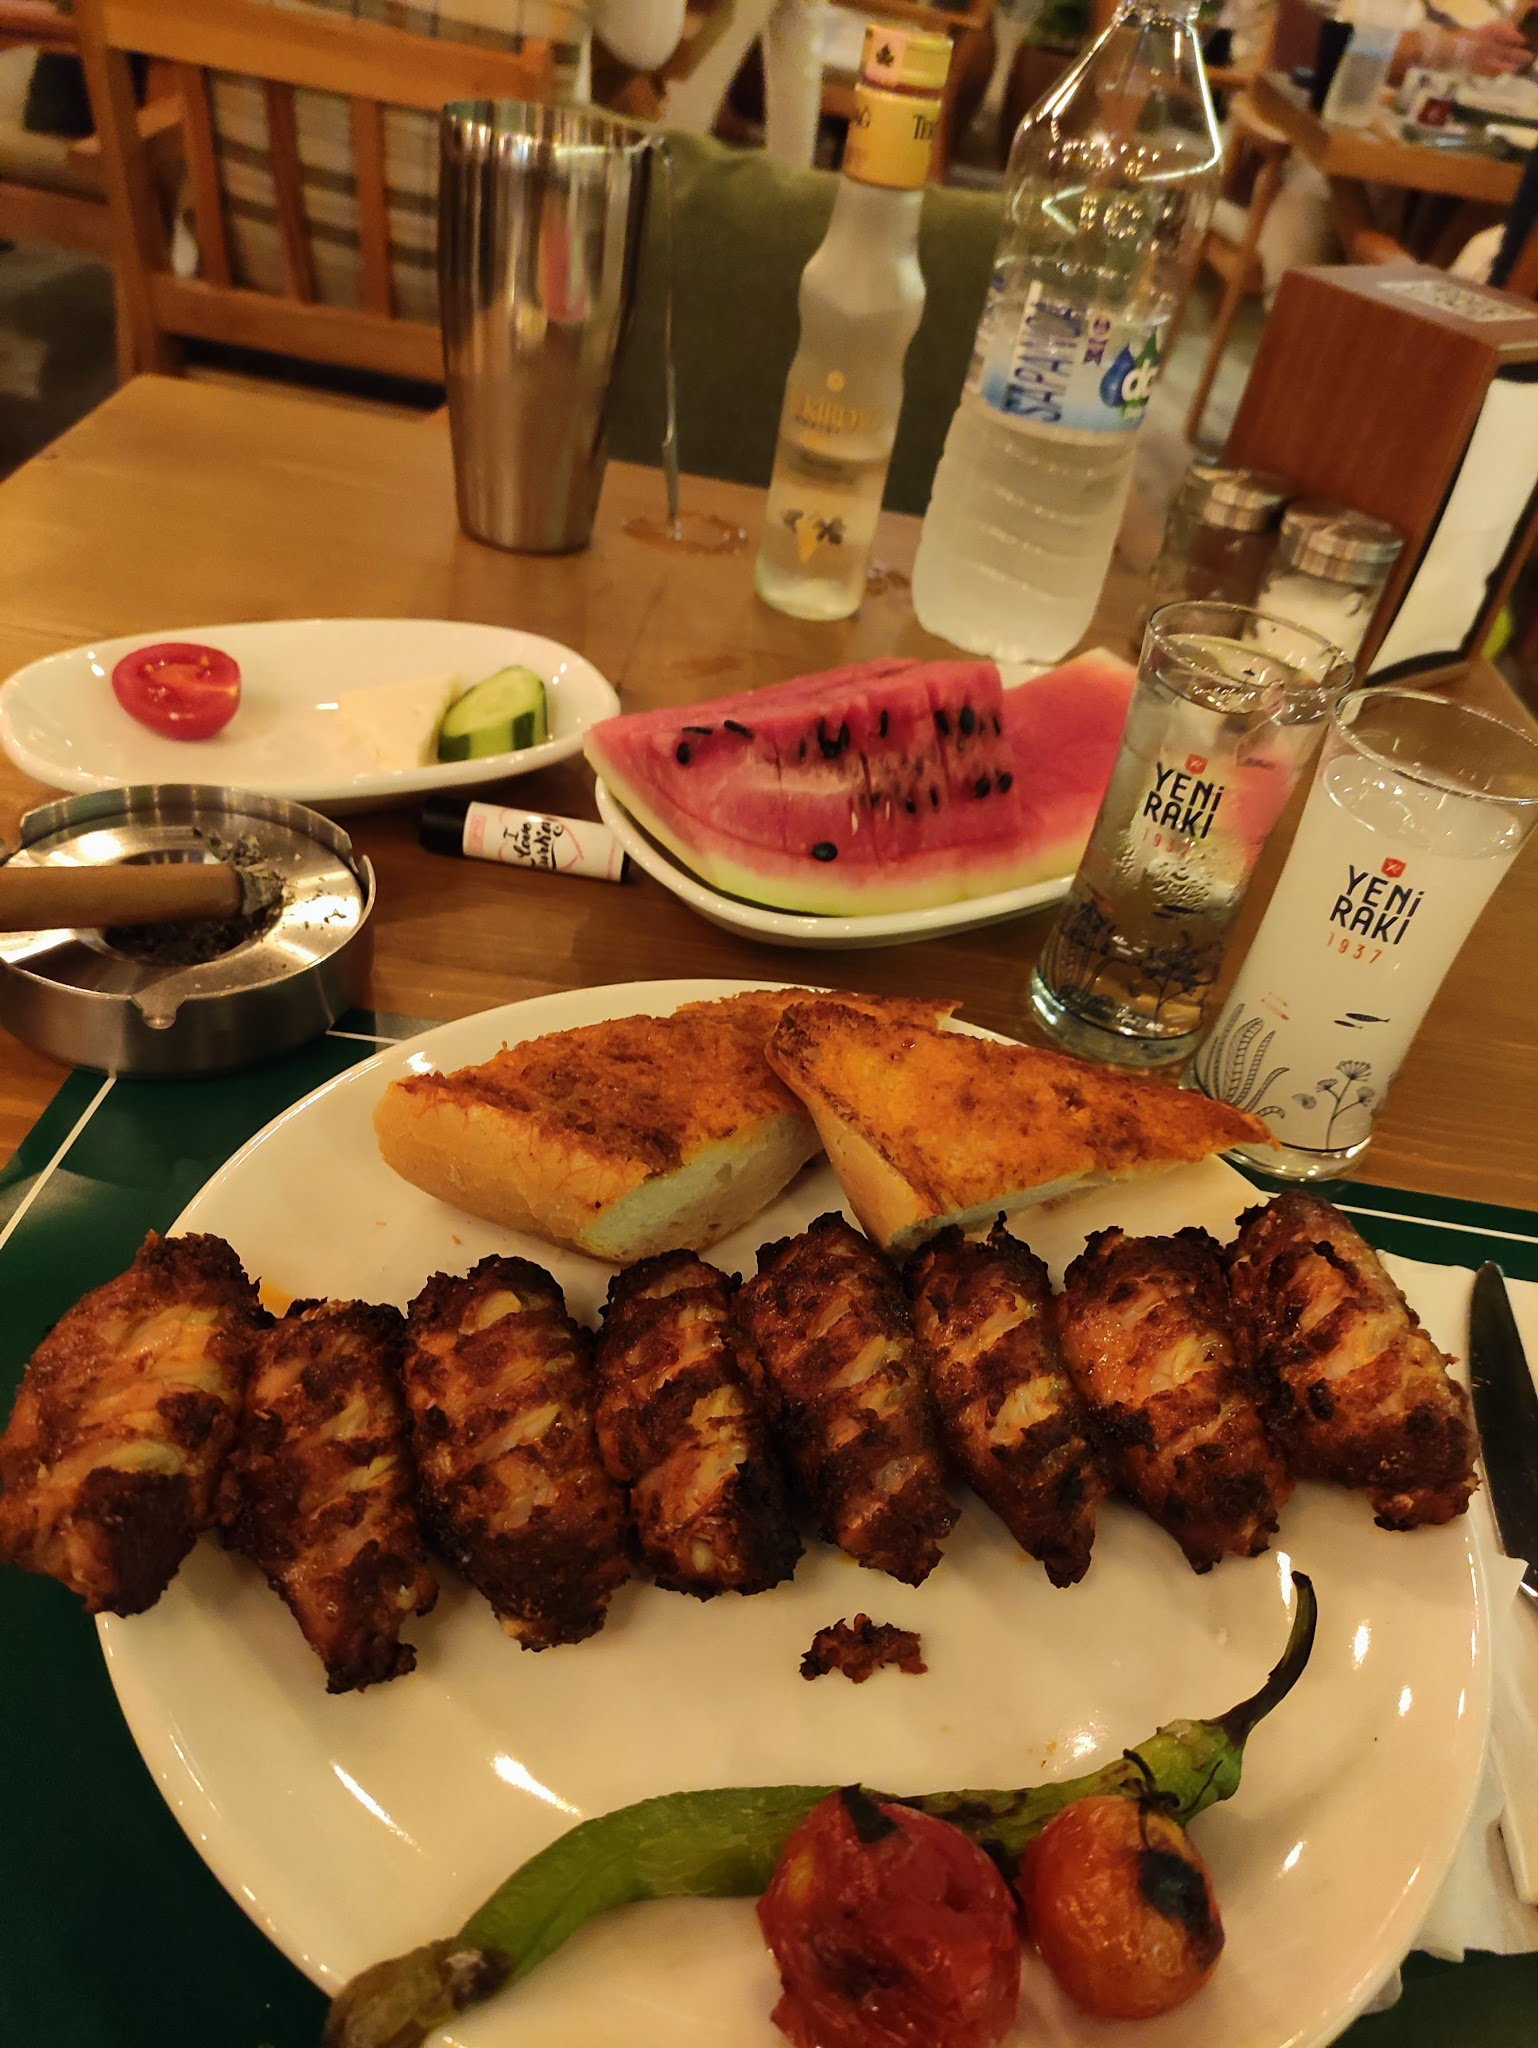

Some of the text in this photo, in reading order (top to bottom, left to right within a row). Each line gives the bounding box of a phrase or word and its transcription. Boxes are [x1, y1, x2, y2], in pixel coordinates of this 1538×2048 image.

[1143, 790, 1214, 839] RAKI
[1329, 894, 1410, 945] RAKI
[1327, 932, 1382, 964] 1937
